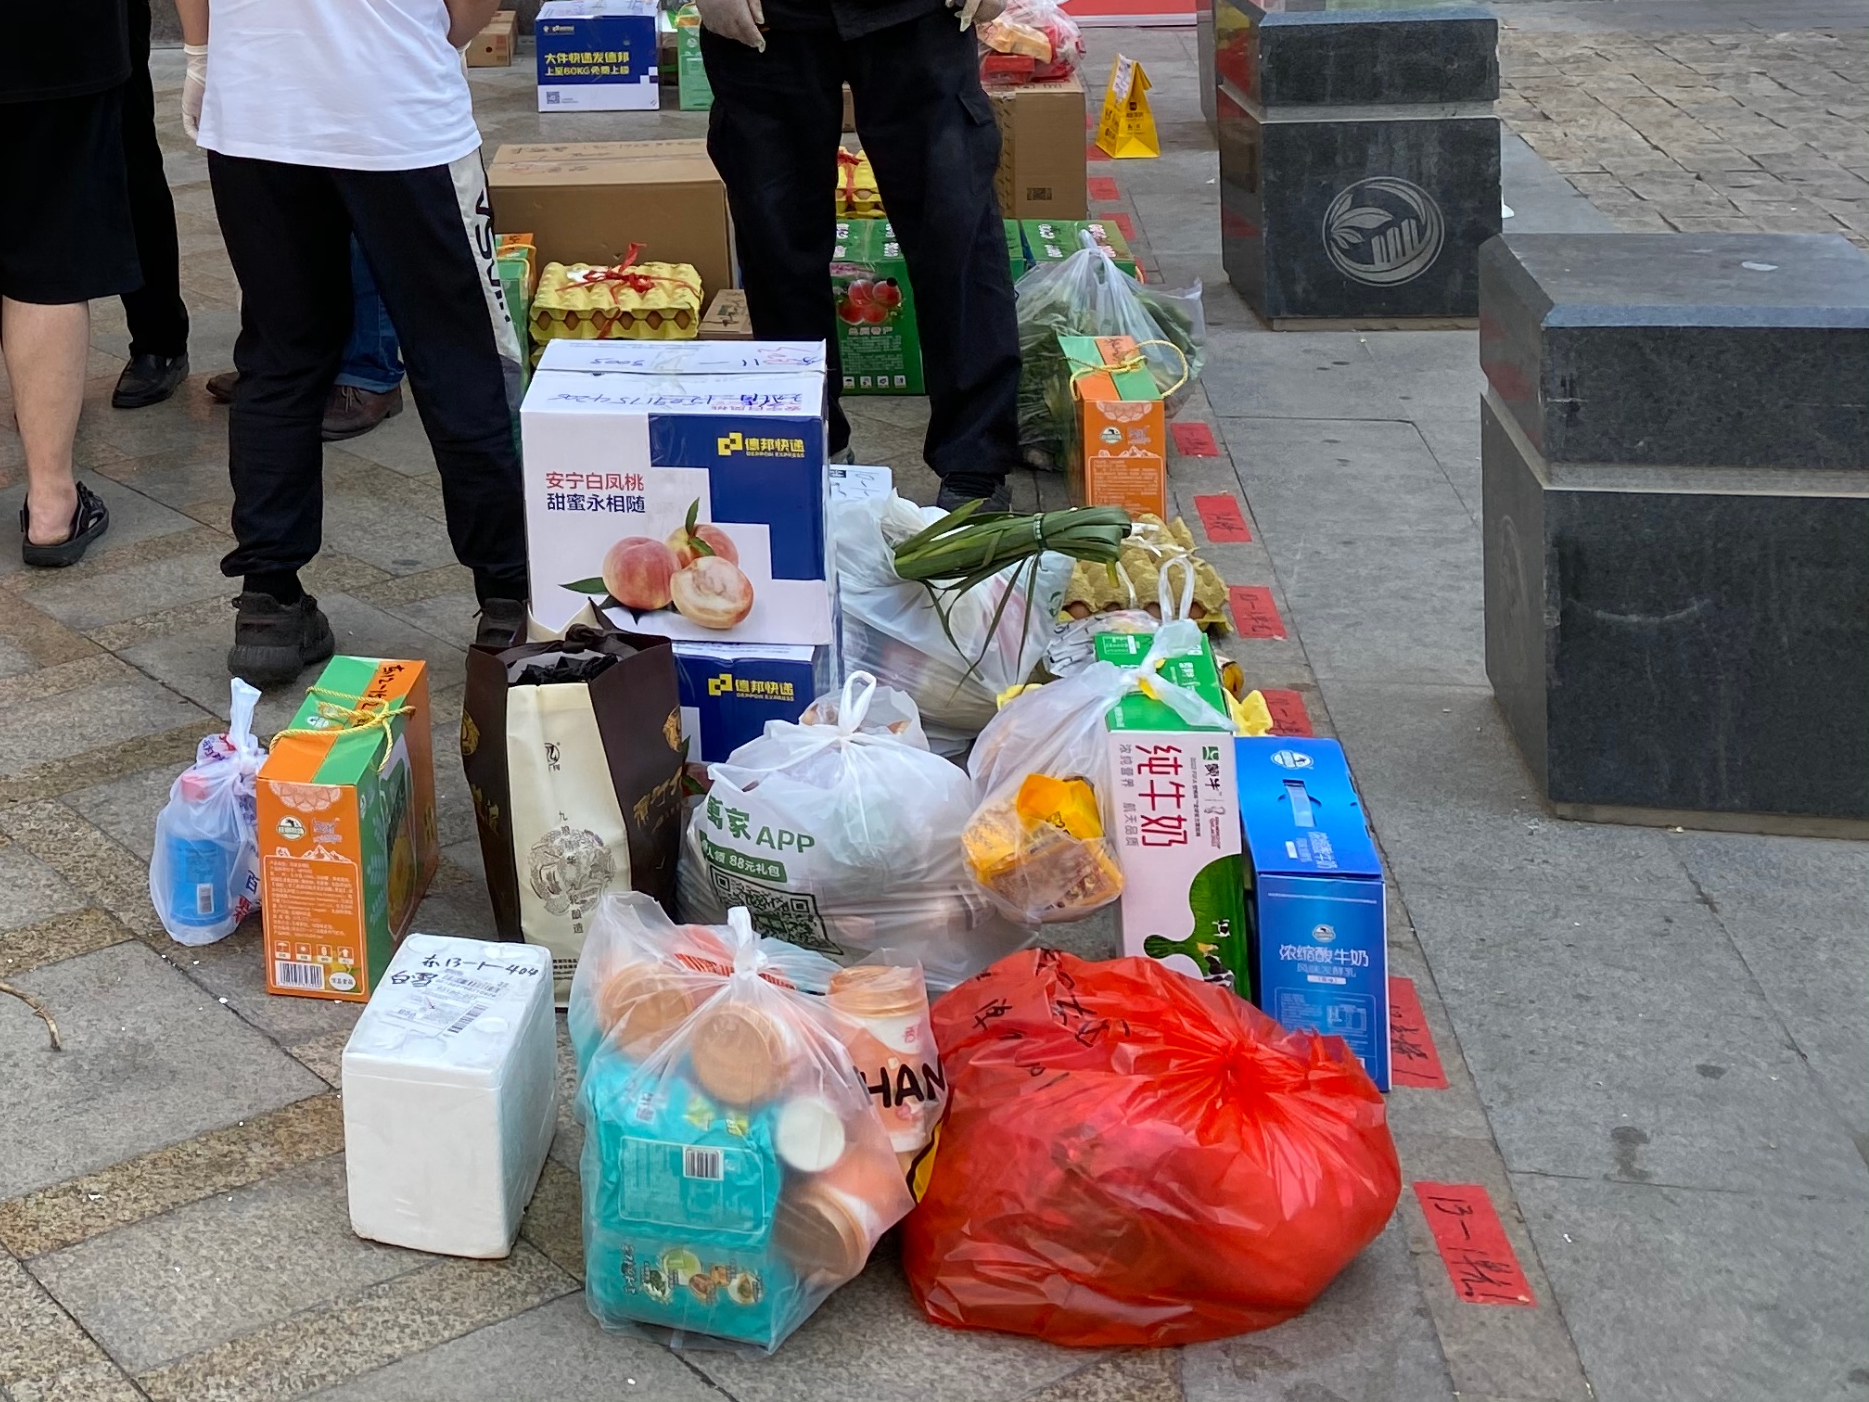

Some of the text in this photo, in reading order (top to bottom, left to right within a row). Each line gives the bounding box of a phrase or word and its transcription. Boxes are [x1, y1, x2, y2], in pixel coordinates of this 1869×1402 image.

[745, 438, 805, 453] 德邦快递
[546, 471, 645, 492] 安宁白凤桃
[546, 493, 646, 514] 甜蜜永相随
[1204, 763, 1221, 793] 蒙牛
[1135, 745, 1188, 847] 纯牛奶
[756, 825, 816, 854] APP
[729, 854, 781, 878] 88元礼包
[1278, 944, 1370, 968] 浓缩酸牛奶
